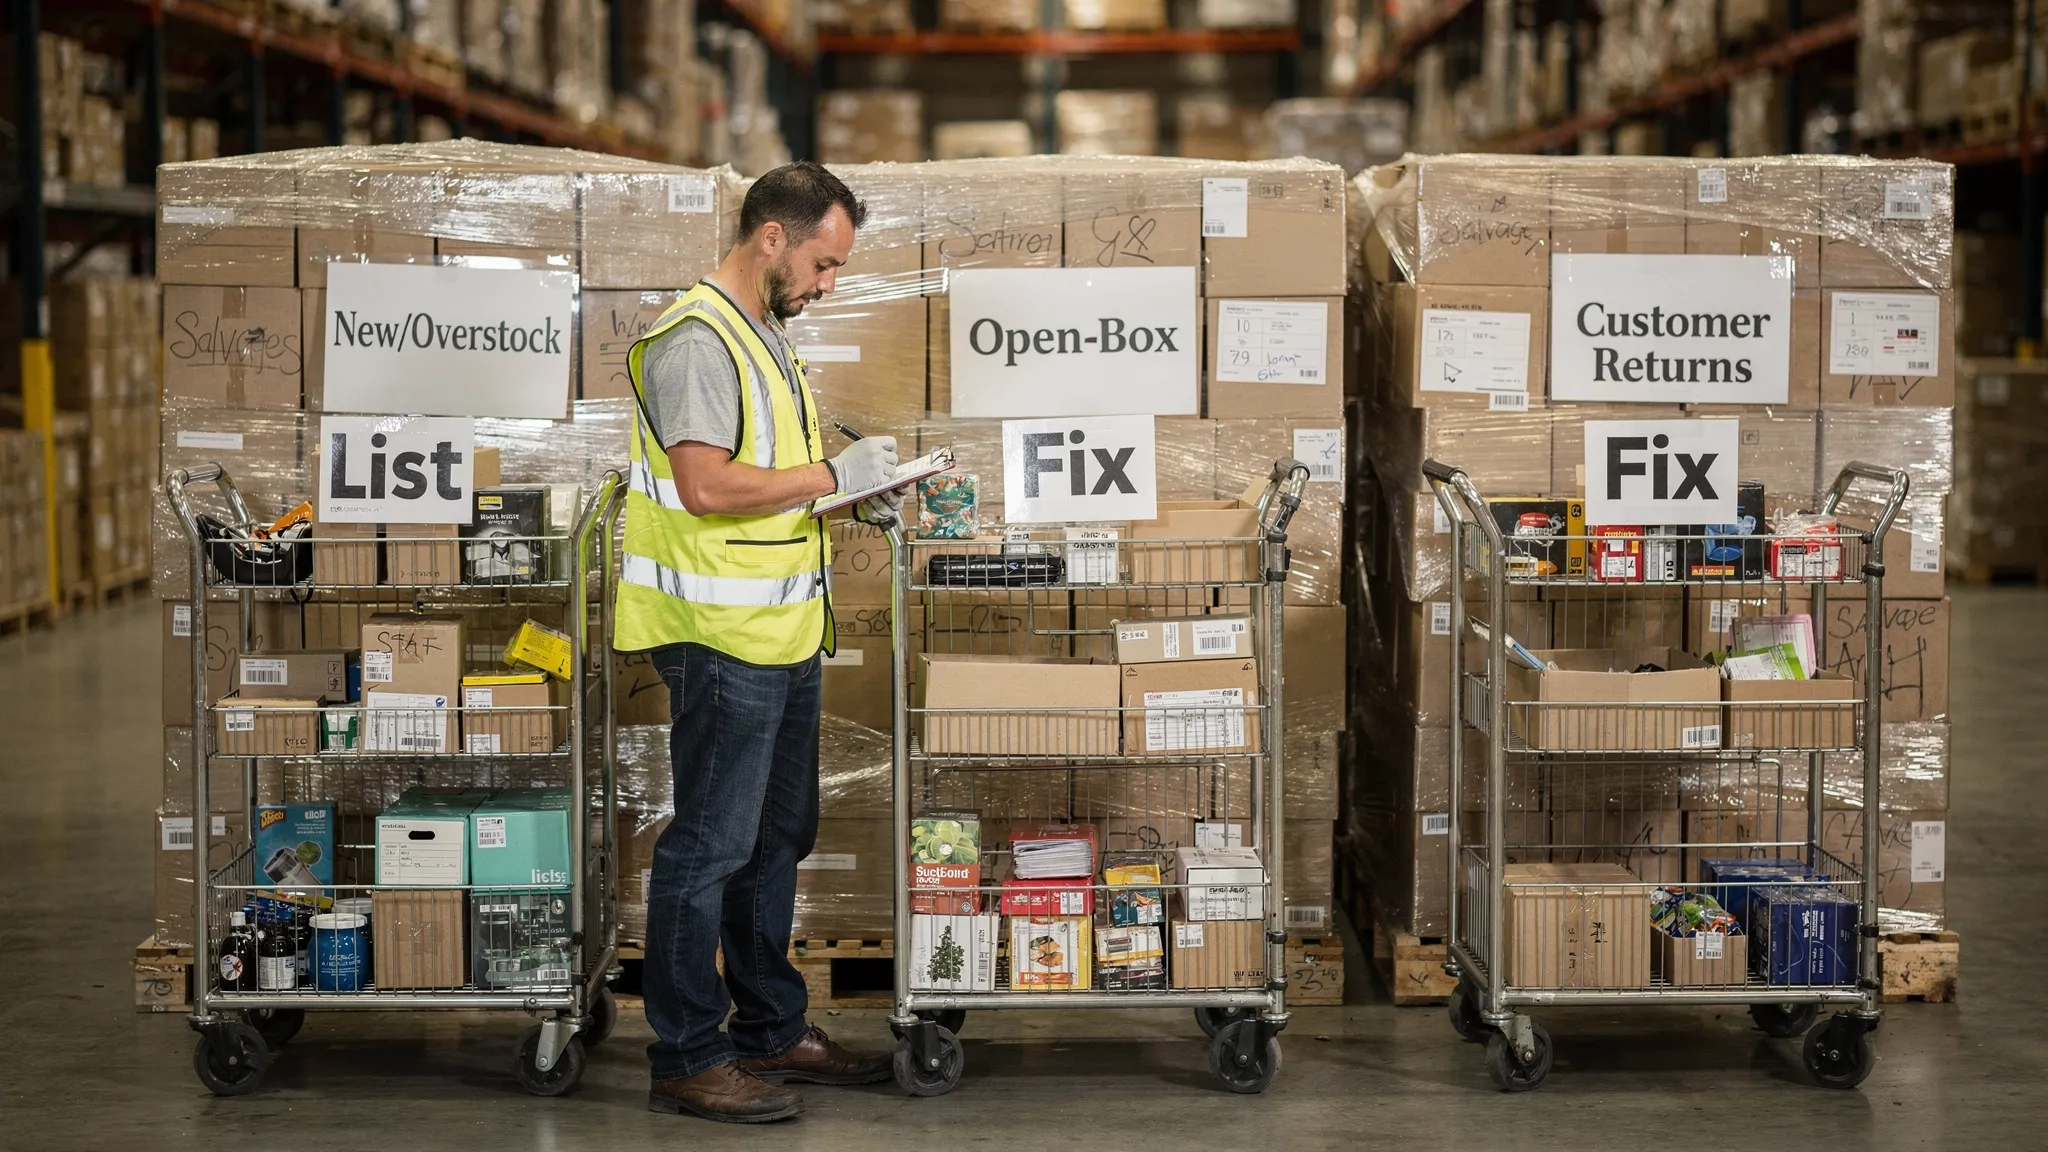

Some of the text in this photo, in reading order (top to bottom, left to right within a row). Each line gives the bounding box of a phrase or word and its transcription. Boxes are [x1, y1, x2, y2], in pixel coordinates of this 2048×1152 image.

[333, 310, 561, 355] New/Overstock
[969, 317, 1179, 366] Open-Box
[1576, 302, 1771, 339] Customer
[1592, 347, 1753, 384] Returns
[331, 433, 462, 500] List
[1022, 430, 1139, 498] Fix
[1606, 433, 1719, 500] Fix
